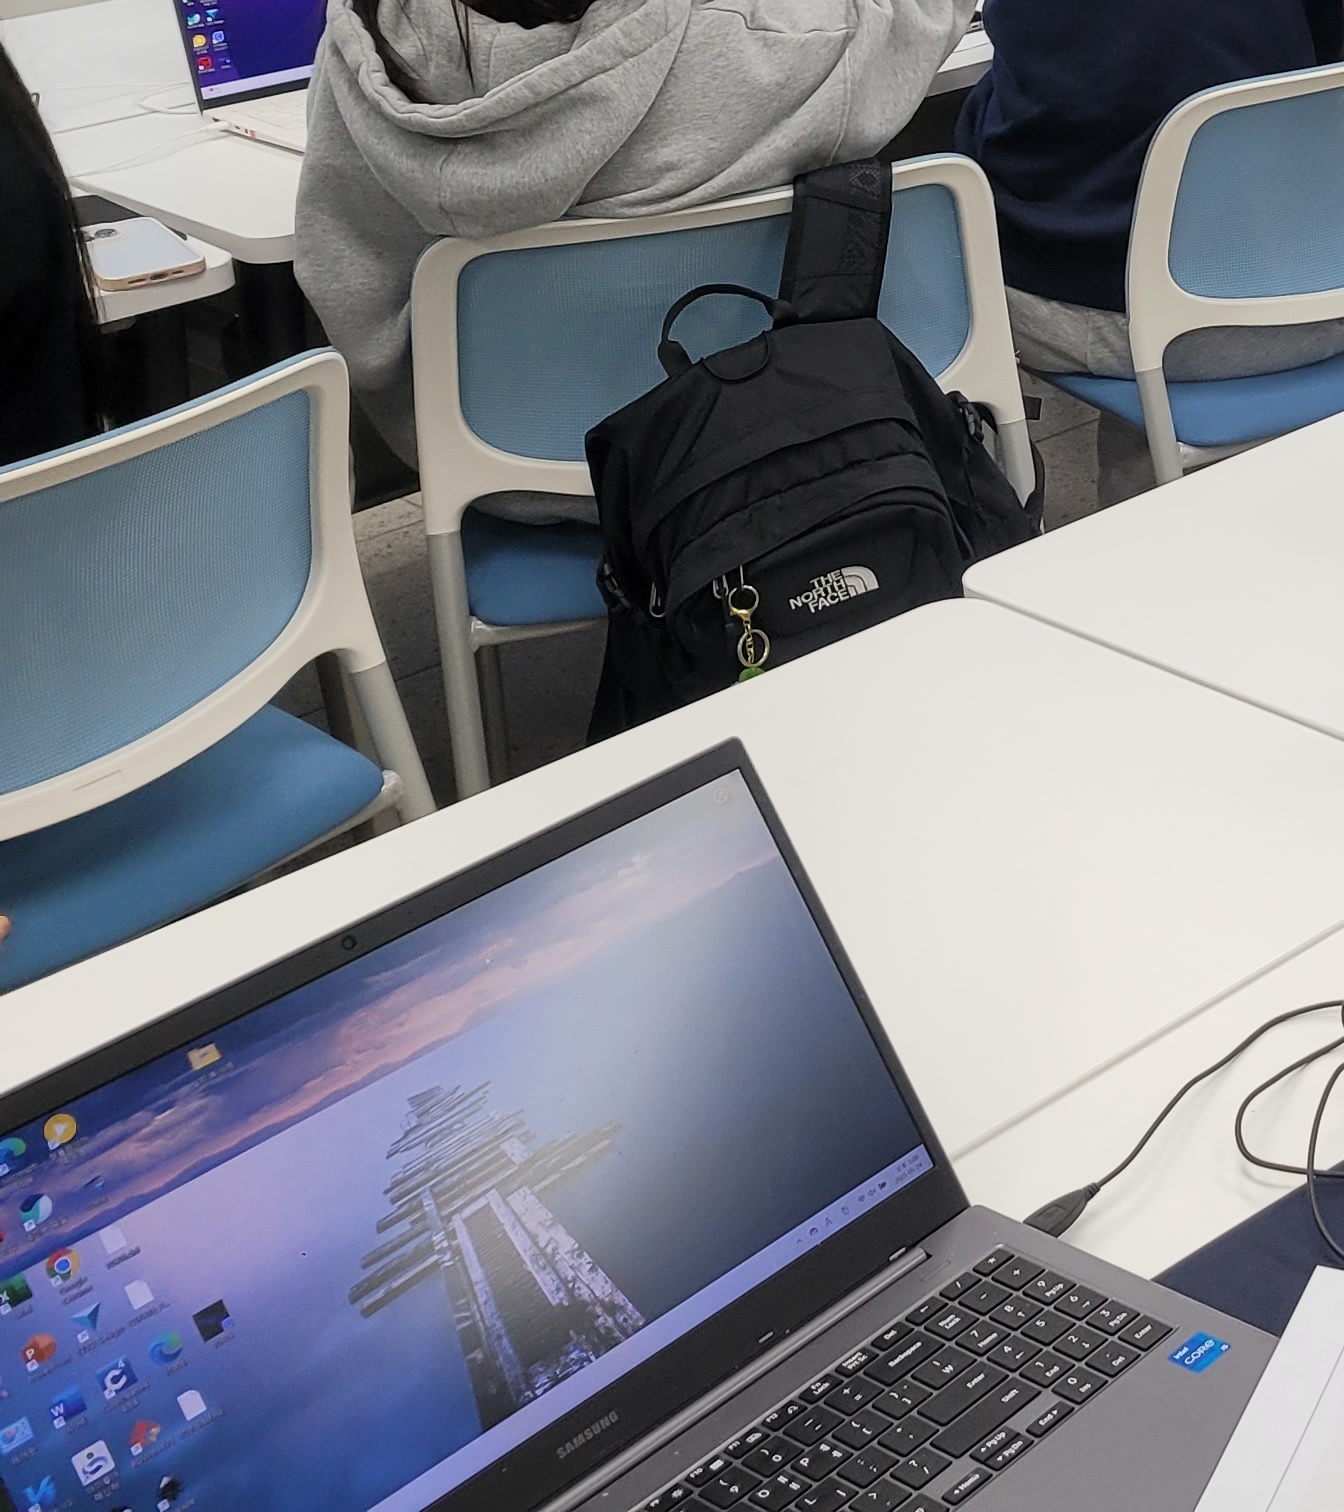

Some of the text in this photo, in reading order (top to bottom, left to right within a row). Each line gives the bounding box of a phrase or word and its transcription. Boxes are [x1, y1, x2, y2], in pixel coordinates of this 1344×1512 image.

[809, 569, 843, 590] THE
[789, 578, 847, 610] NORTH
[808, 589, 850, 614] FACE
[1133, 1324, 1153, 1339] Enter
[887, 1340, 923, 1368] Backspace
[965, 1371, 986, 1389] Enter
